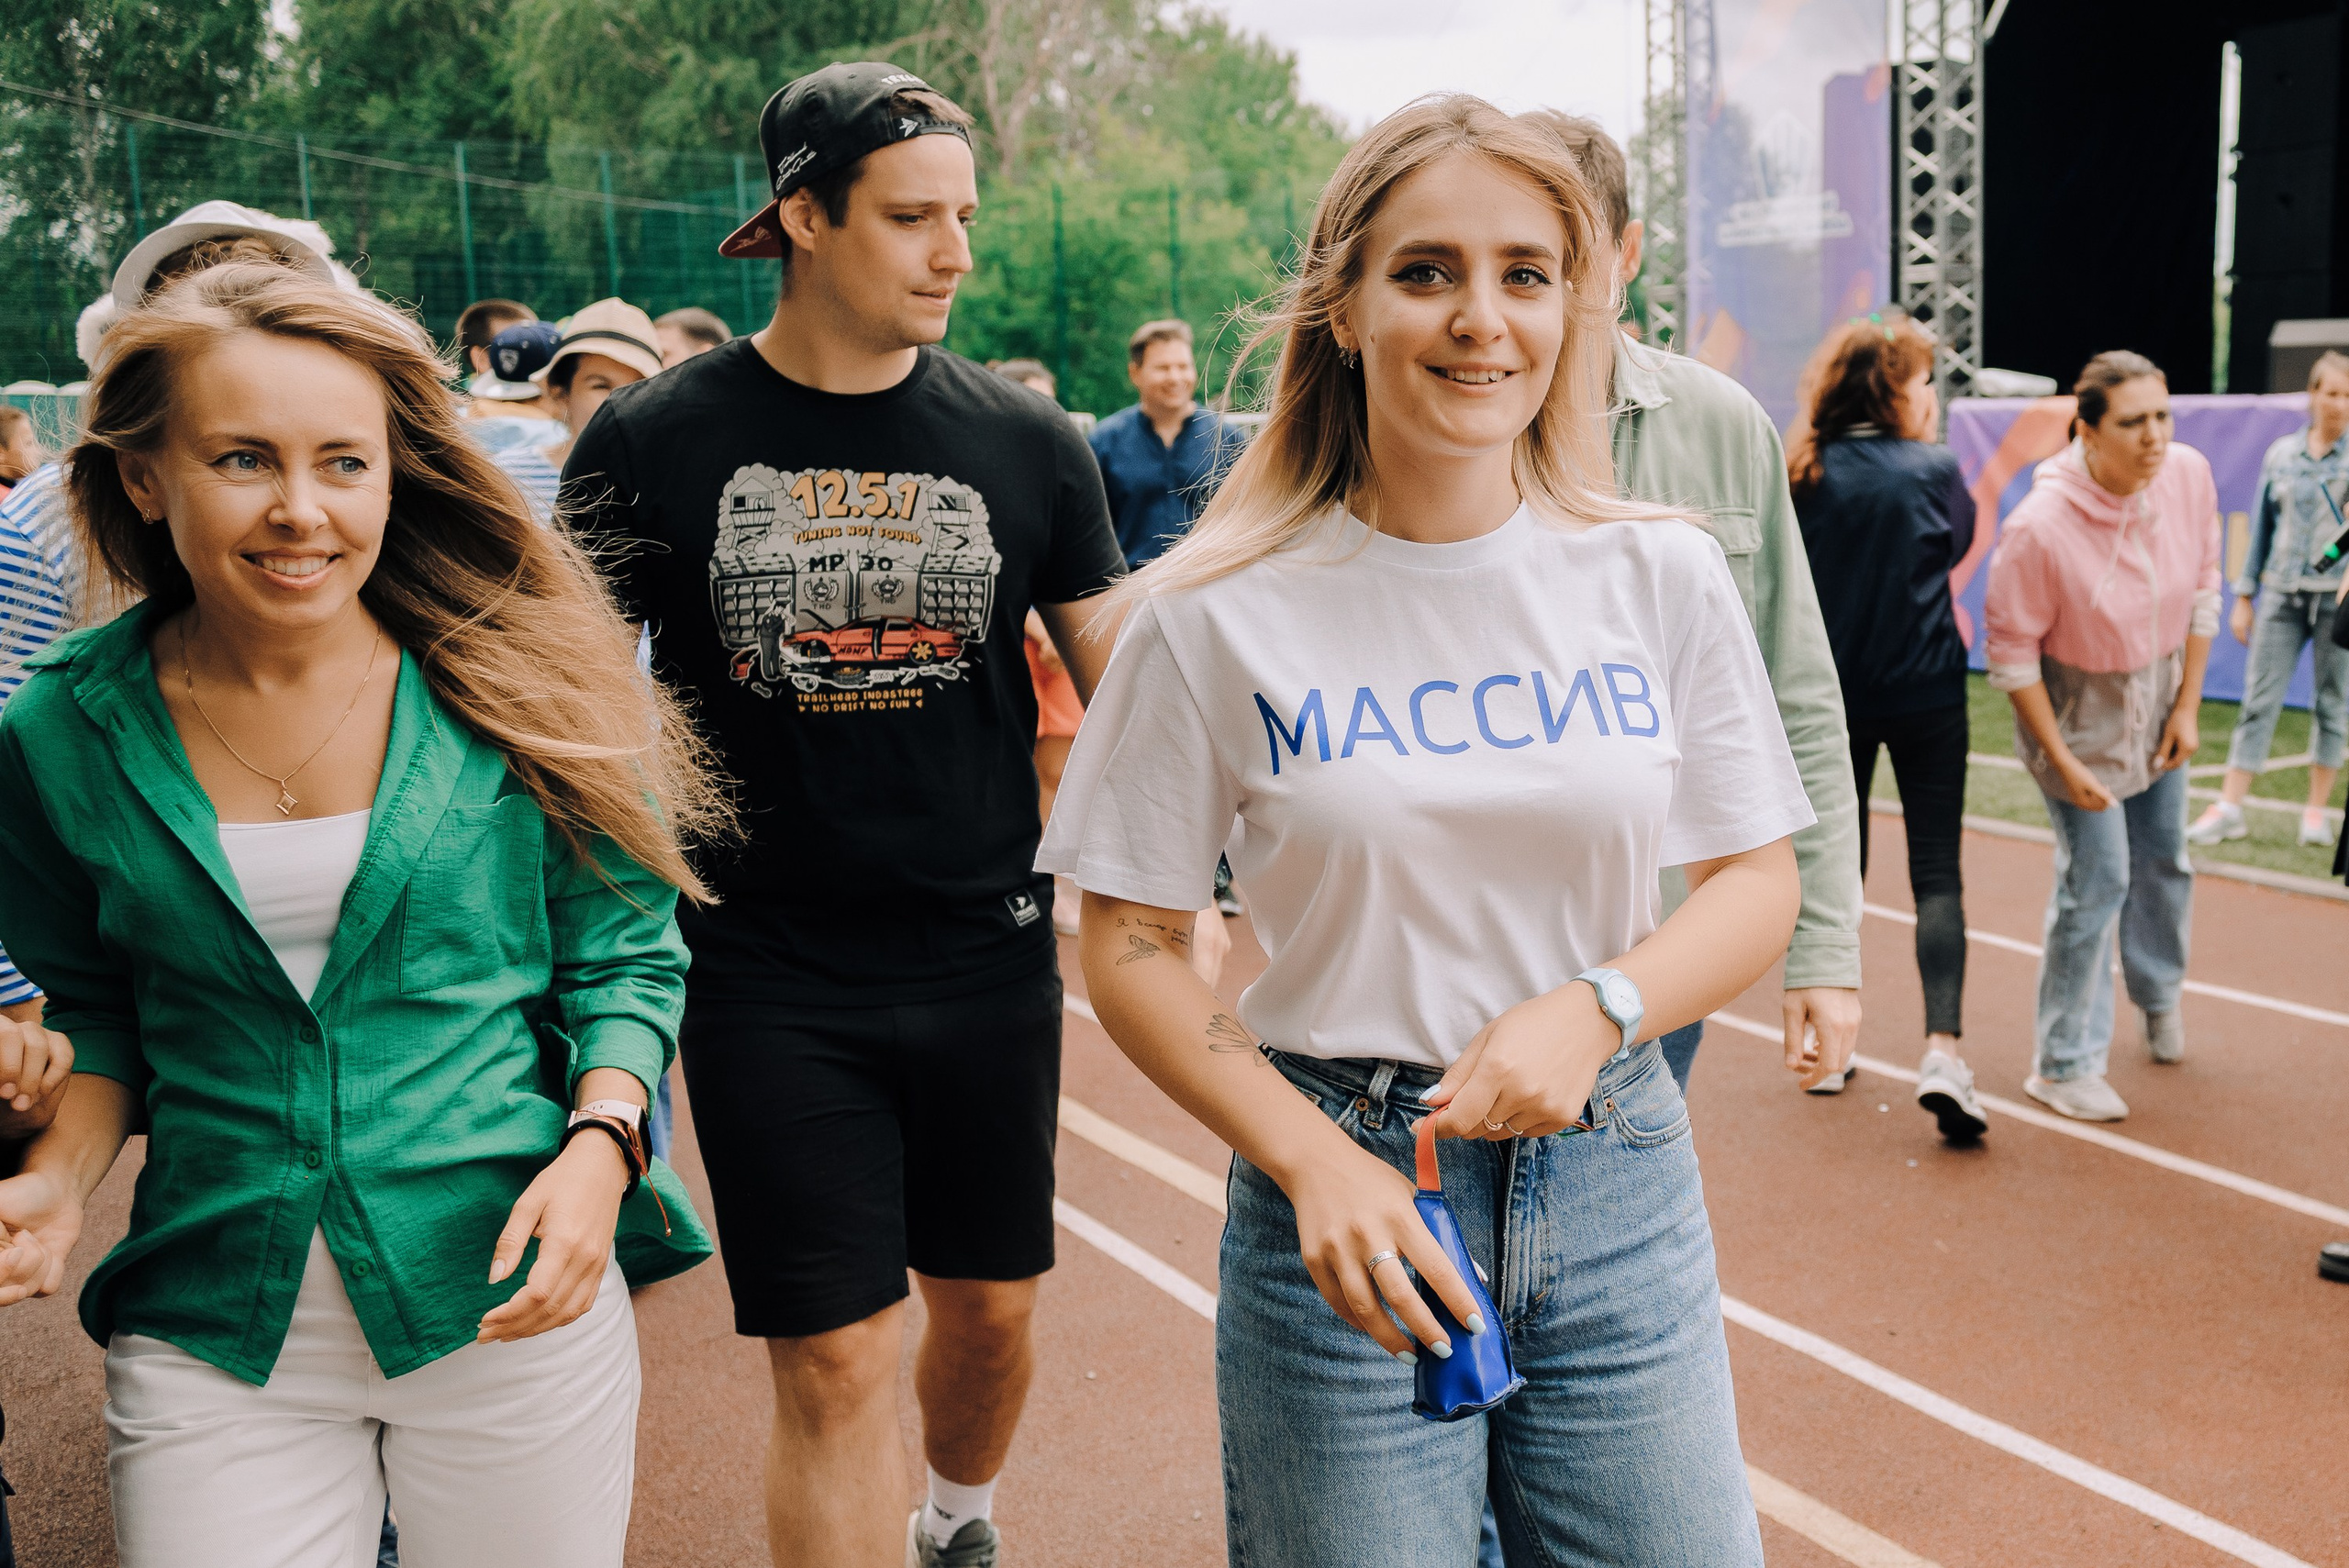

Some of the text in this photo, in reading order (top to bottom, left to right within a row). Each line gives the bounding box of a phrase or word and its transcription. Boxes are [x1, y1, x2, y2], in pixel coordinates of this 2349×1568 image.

[789, 470, 920, 521] 12.5.1
[793, 525, 922, 545] TUNING NOT FOUND
[796, 692, 859, 703] TRAILHEAD
[812, 699, 909, 712] NO DRIFT NO FUN
[1252, 662, 1659, 776] МАССИВ
